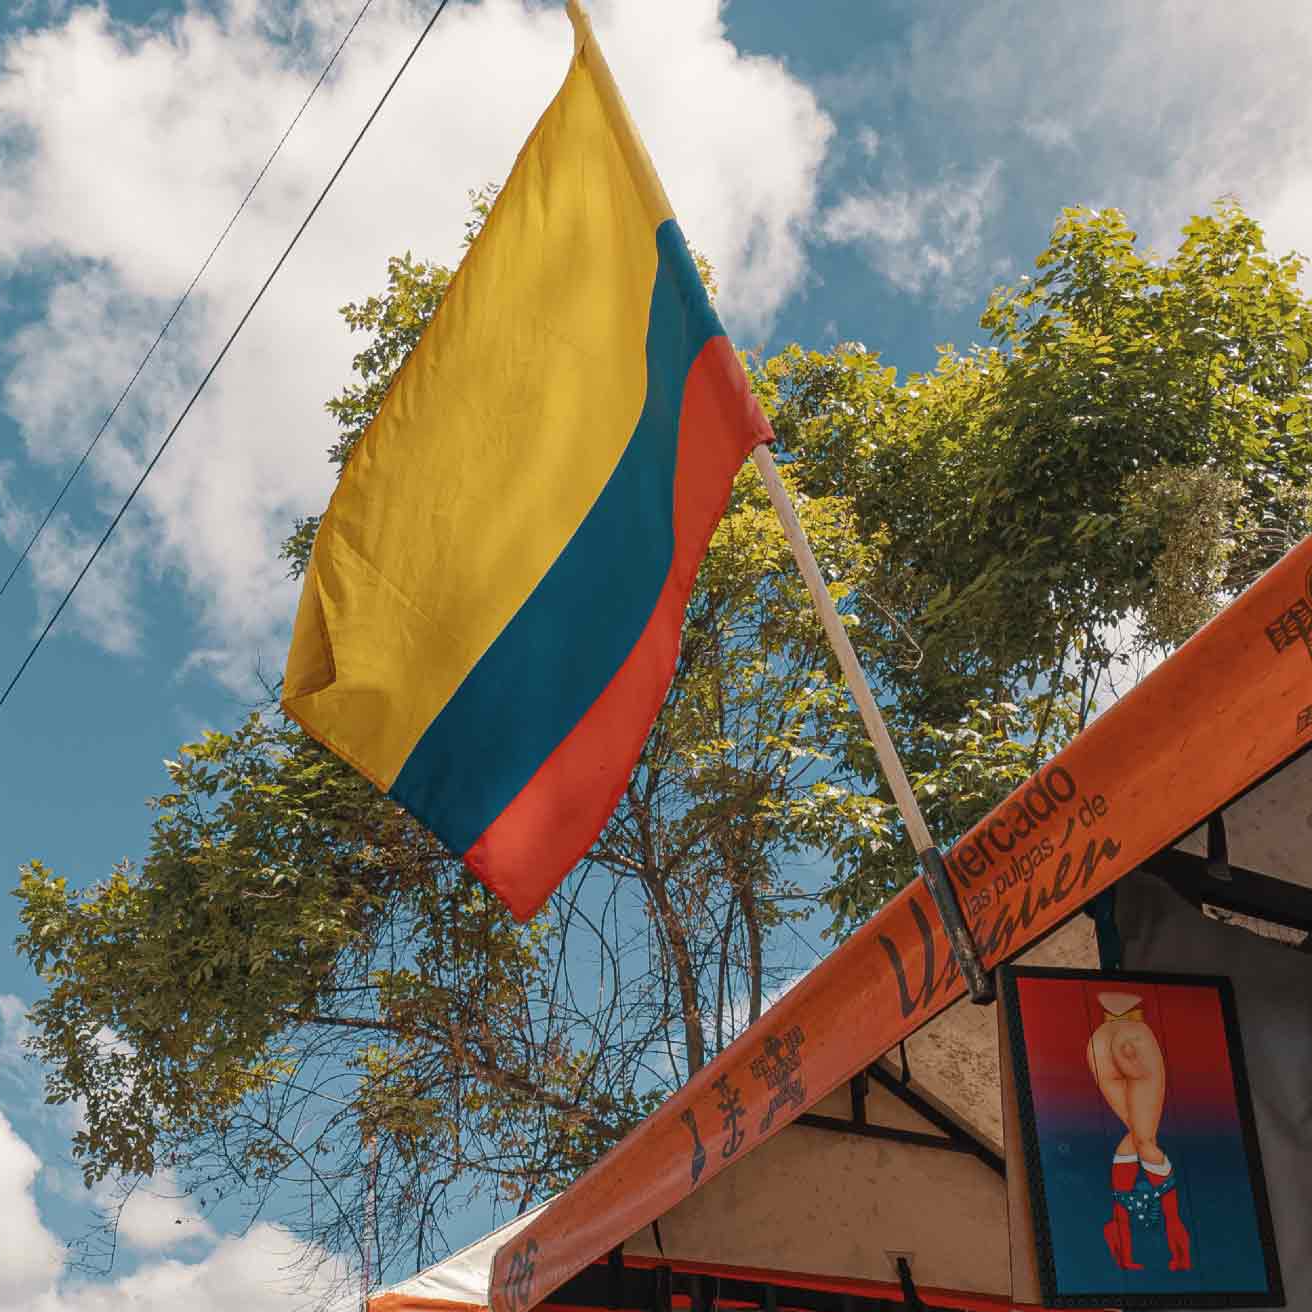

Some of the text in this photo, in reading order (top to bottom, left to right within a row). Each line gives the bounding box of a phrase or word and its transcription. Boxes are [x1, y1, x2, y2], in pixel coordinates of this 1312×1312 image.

[948, 765, 1077, 889] ercado
[963, 793, 1110, 919] las pulgas de
